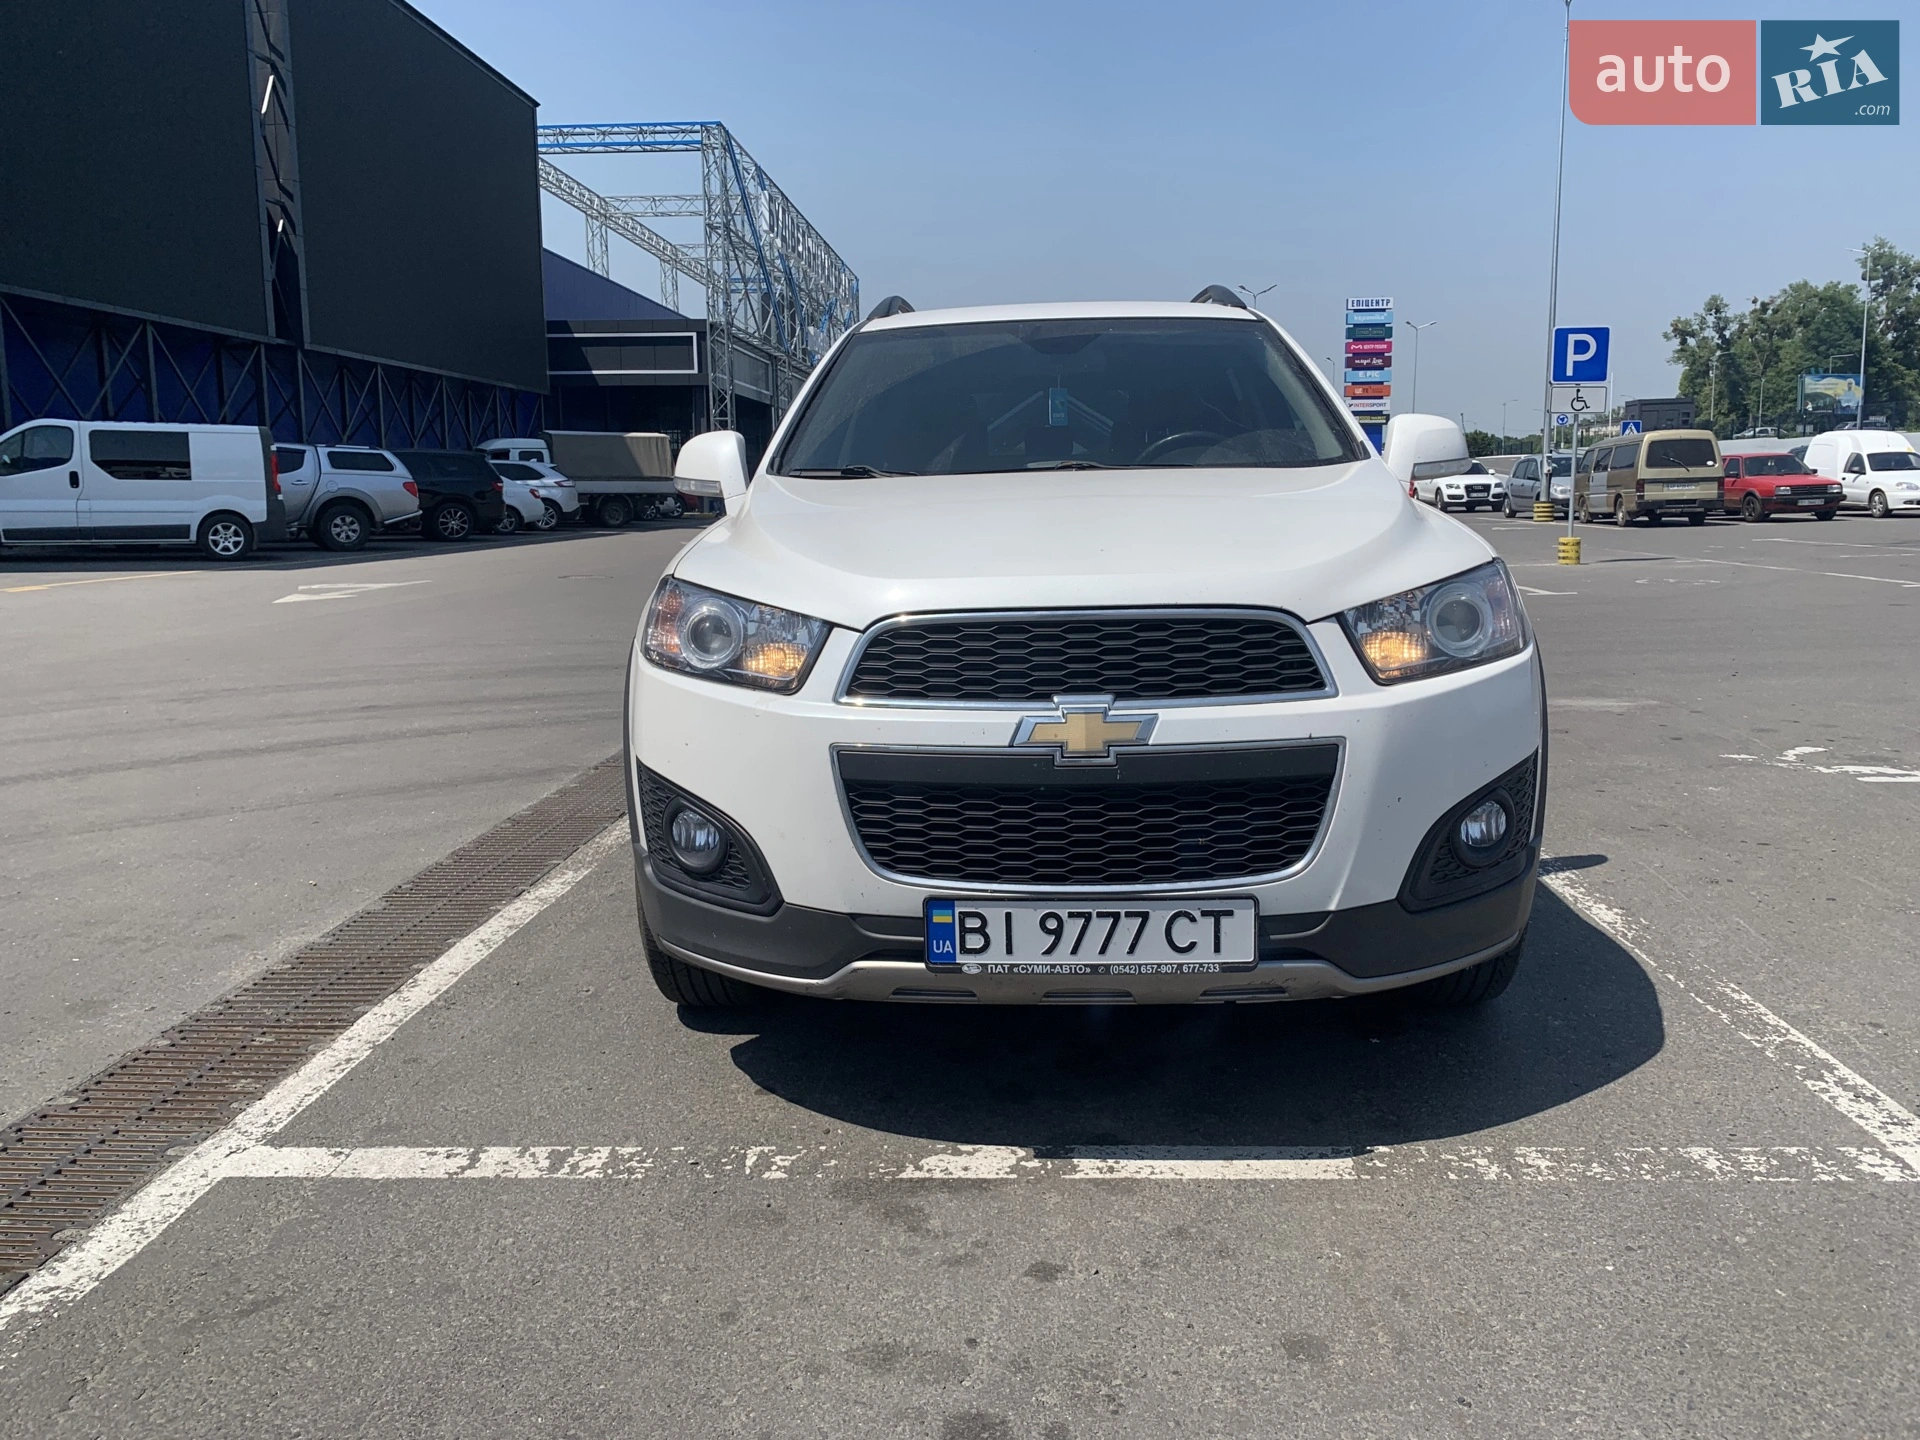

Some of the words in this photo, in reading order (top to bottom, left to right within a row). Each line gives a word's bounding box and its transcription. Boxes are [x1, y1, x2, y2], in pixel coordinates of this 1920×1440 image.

[1351, 298, 1391, 308] ЕПІЦЕНТР
[1566, 333, 1597, 376] P
[958, 910, 1013, 955] BI
[1039, 910, 1149, 956] 9777
[1164, 909, 1235, 954] CT
[933, 939, 953, 953] UA
[987, 964, 1010, 974] ПАТ
[1013, 964, 1091, 974] «СУМИ-АВТО»
[1109, 964, 1139, 975] (0542)
[1140, 964, 1180, 974] 657-907,
[1182, 963, 1220, 973] 677-733
